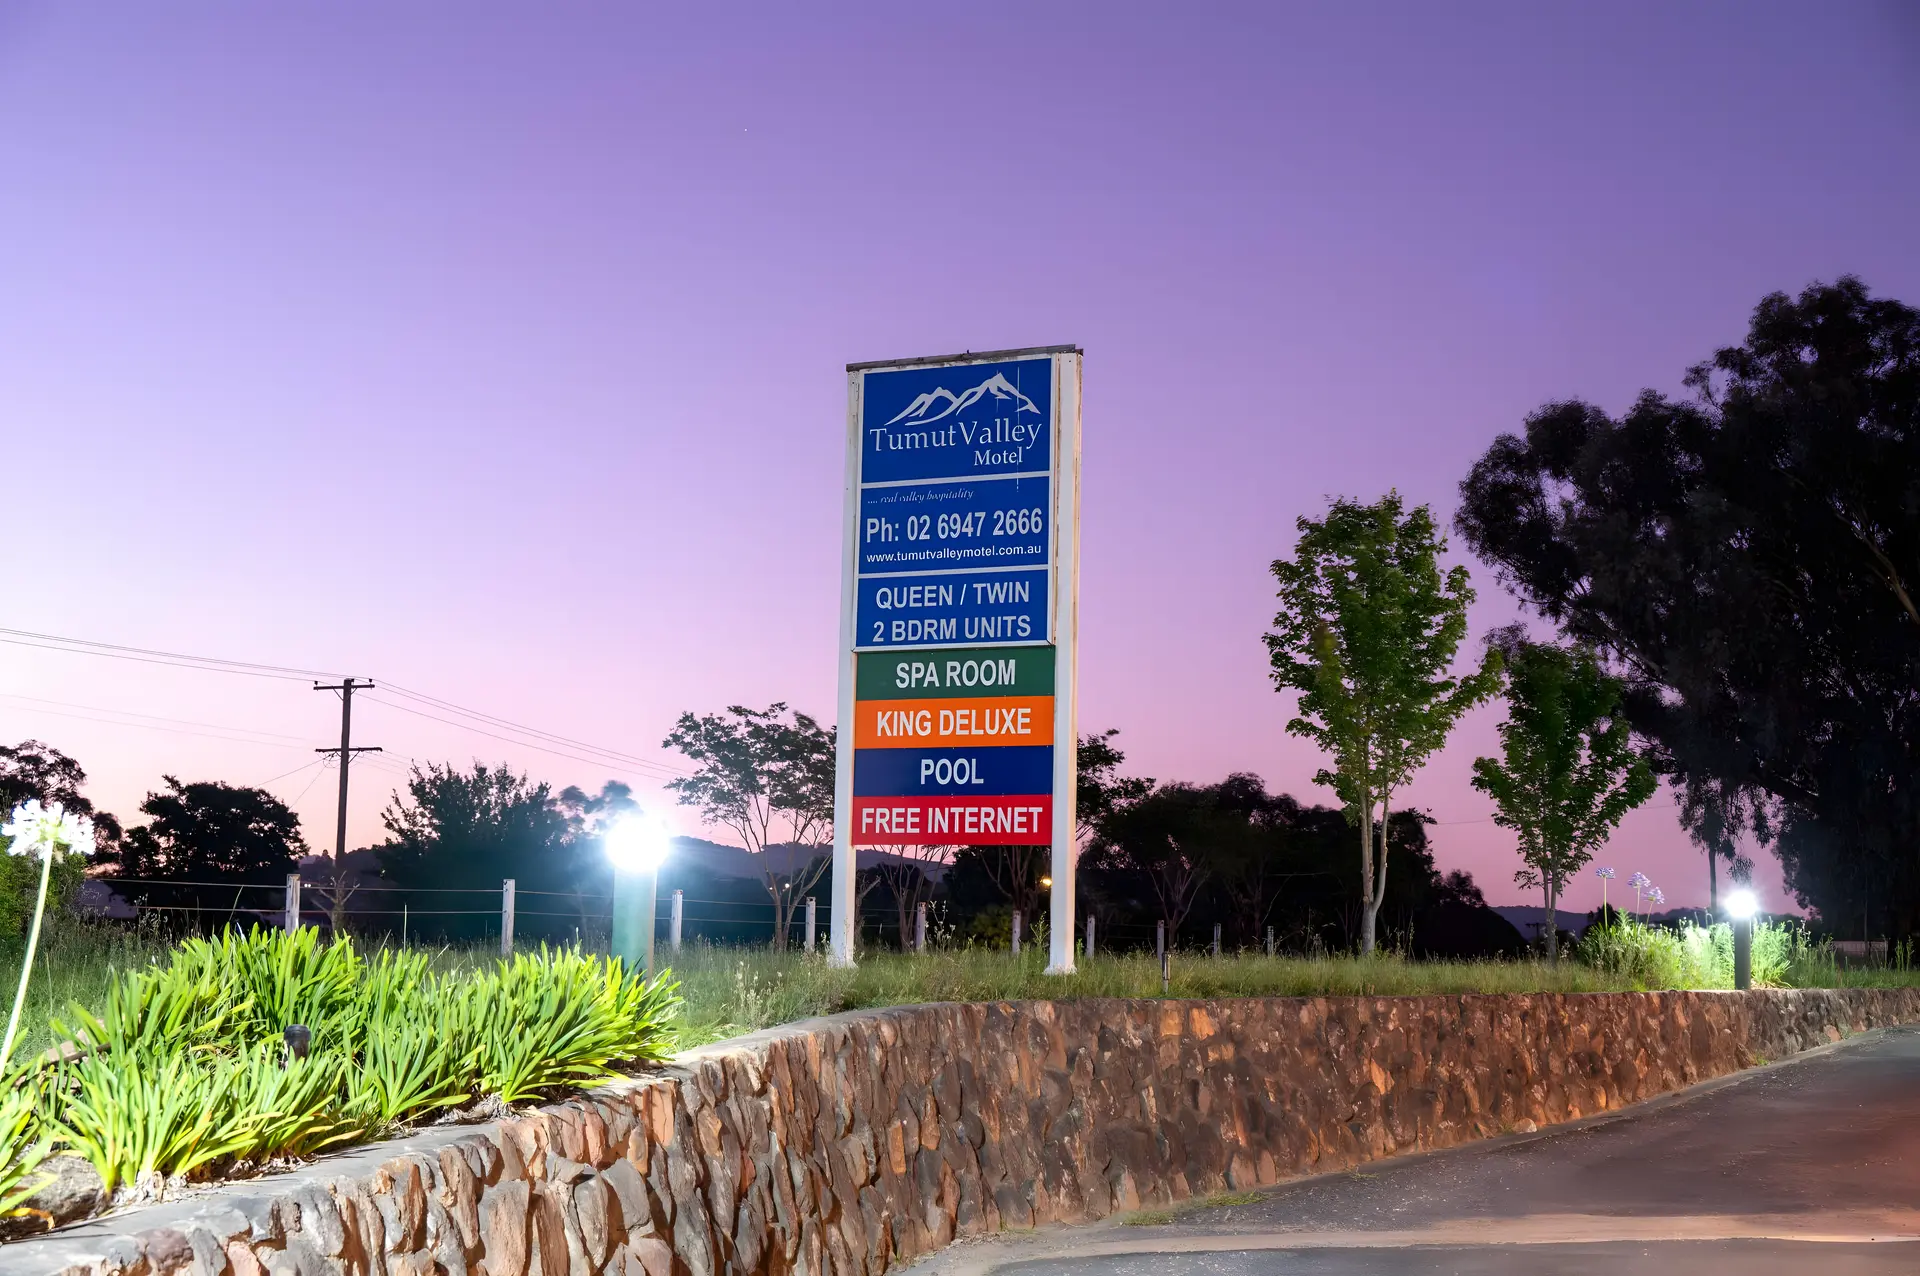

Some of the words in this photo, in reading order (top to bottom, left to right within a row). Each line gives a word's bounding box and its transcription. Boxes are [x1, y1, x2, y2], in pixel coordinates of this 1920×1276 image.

[974, 447, 1023, 465] Motel
[866, 518, 899, 542] Ph:
[907, 515, 930, 540] 02
[937, 512, 986, 539] 6947
[993, 508, 1042, 536] 2666
[867, 545, 1041, 562] www.tumutvalleymotel.com.au
[876, 585, 953, 609] QUEEN
[973, 581, 1029, 604] TWIN
[873, 622, 884, 642] 2
[892, 618, 956, 641] BDRM
[965, 615, 1031, 639] UNITS
[896, 662, 939, 688] SPA
[946, 659, 1015, 687] ROOM
[877, 710, 931, 736] KING
[939, 708, 1031, 736] DELUXE
[921, 758, 984, 785] POOL
[862, 808, 920, 833] FREE
[928, 807, 1042, 833] INTERNET
